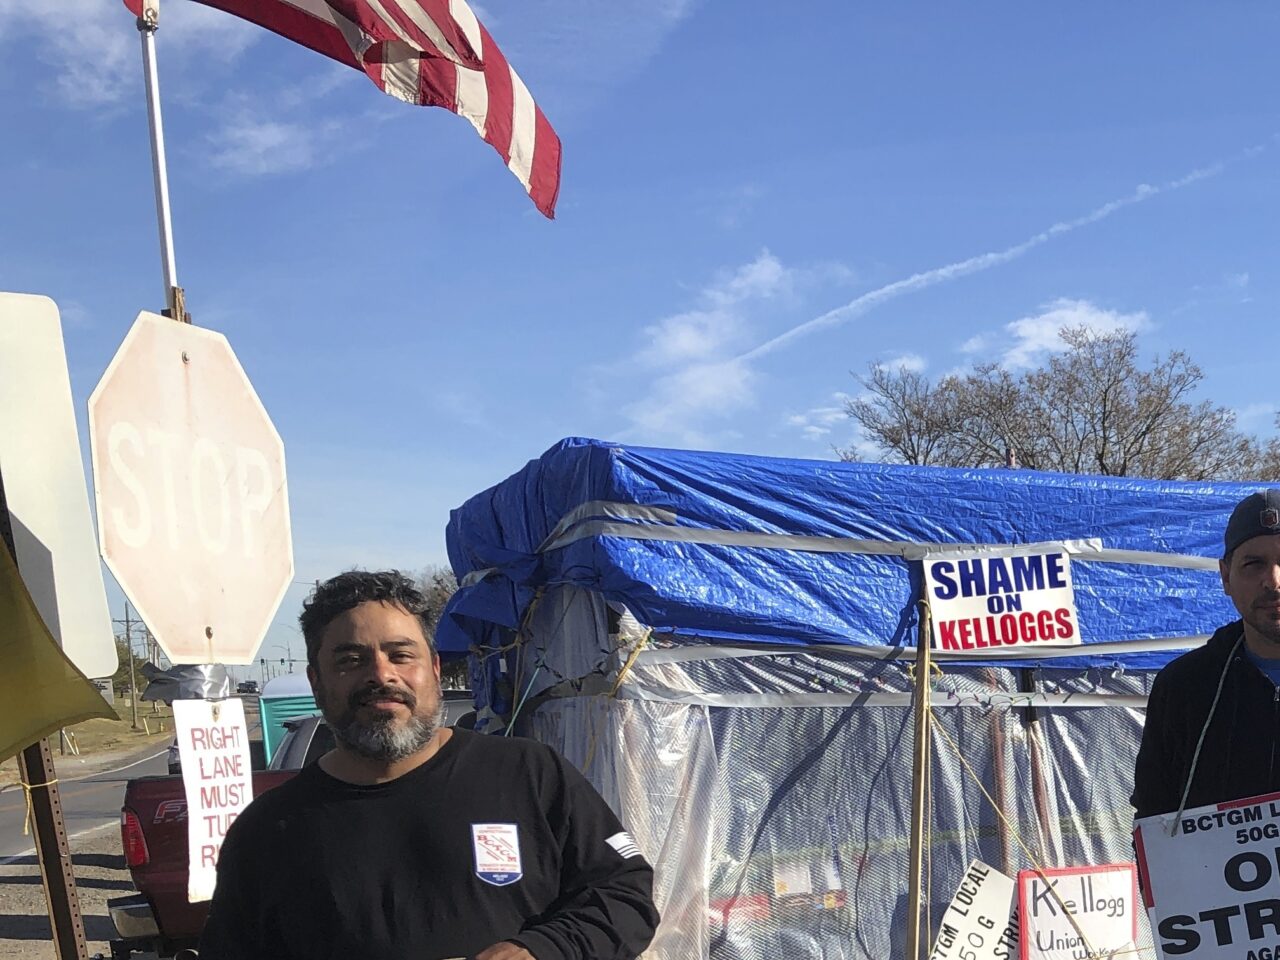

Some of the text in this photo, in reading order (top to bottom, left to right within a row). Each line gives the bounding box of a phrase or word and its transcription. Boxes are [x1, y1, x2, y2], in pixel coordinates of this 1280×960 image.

[108, 421, 273, 559] STOP
[931, 553, 1067, 600] SHAME
[987, 593, 1023, 614] ON
[939, 608, 1074, 651] KELLOGGS
[190, 725, 240, 751] RIGHT
[199, 754, 244, 780] LANE
[200, 783, 245, 810] MUST
[1182, 806, 1263, 835] BCTGM
[1235, 824, 1279, 844] 50G
[950, 866, 990, 917] LOCAL
[1032, 876, 1125, 918] Kellogg
[1036, 930, 1085, 952] Union
